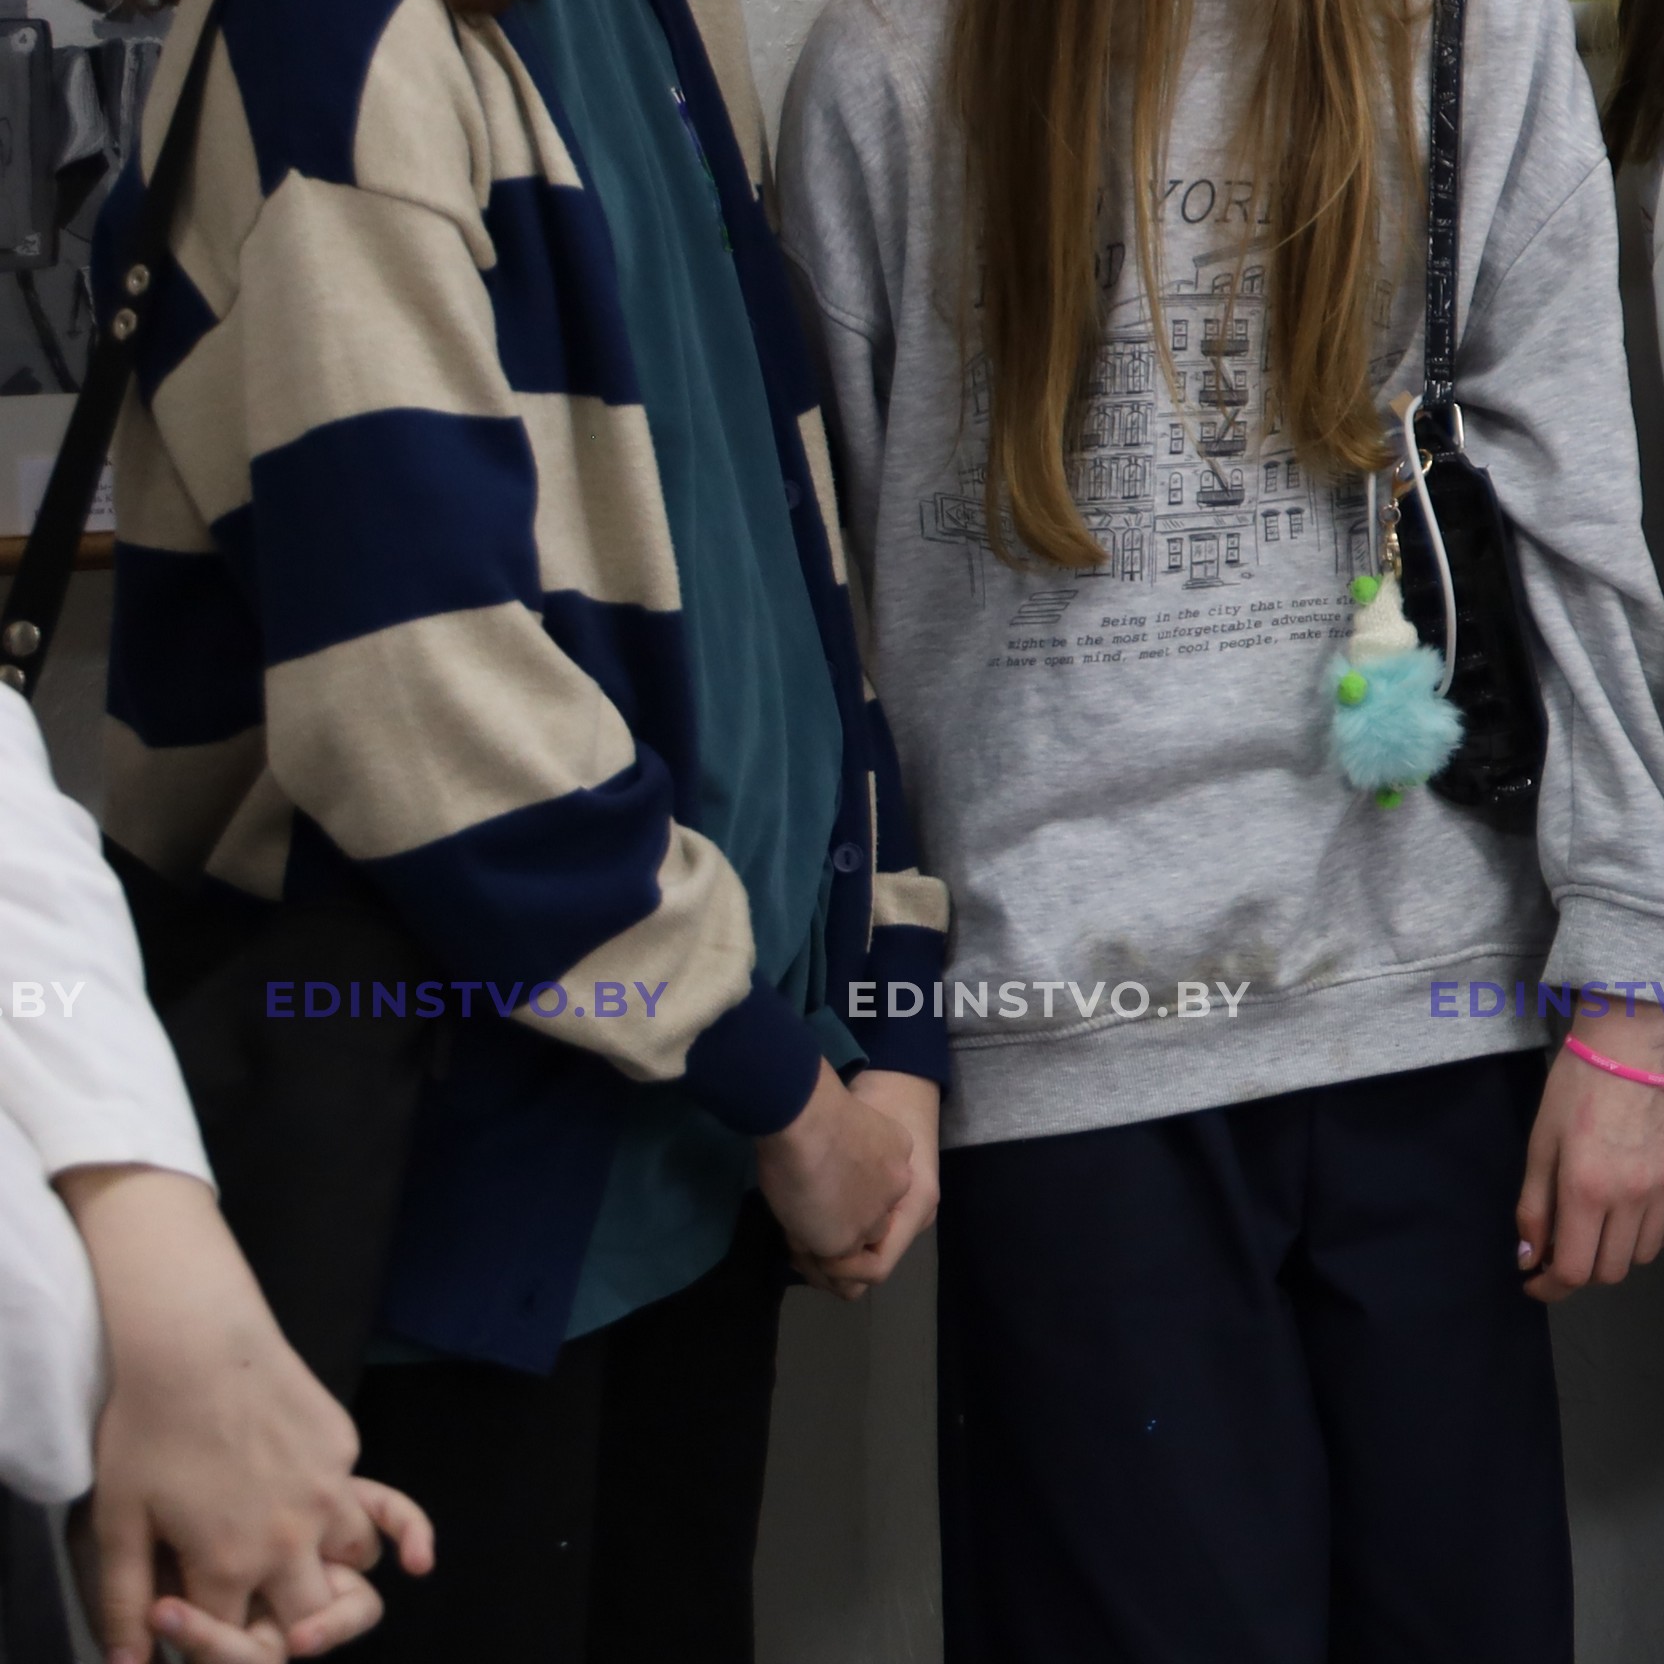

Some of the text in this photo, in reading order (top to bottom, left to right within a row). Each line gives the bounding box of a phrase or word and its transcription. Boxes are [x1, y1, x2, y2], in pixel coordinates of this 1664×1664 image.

[1051, 636, 1068, 648] be
[1076, 635, 1104, 647] the
[1111, 632, 1149, 645] most
[1156, 619, 1263, 642] unforgettable
[1271, 612, 1341, 627] adventure
[1101, 614, 1147, 628] Being
[1155, 612, 1171, 624] in
[1177, 608, 1201, 620] the
[1208, 604, 1242, 618] city
[1250, 600, 1284, 613] that
[1291, 596, 1329, 608] never
[1006, 653, 1037, 667] have
[1044, 656, 1074, 668] open
[1082, 650, 1128, 665] mind,
[1138, 647, 1172, 661] meet
[1177, 641, 1210, 655] cool
[1218, 633, 1279, 652] people,
[1289, 628, 1322, 641] make
[1327, 626, 1356, 640] frie
